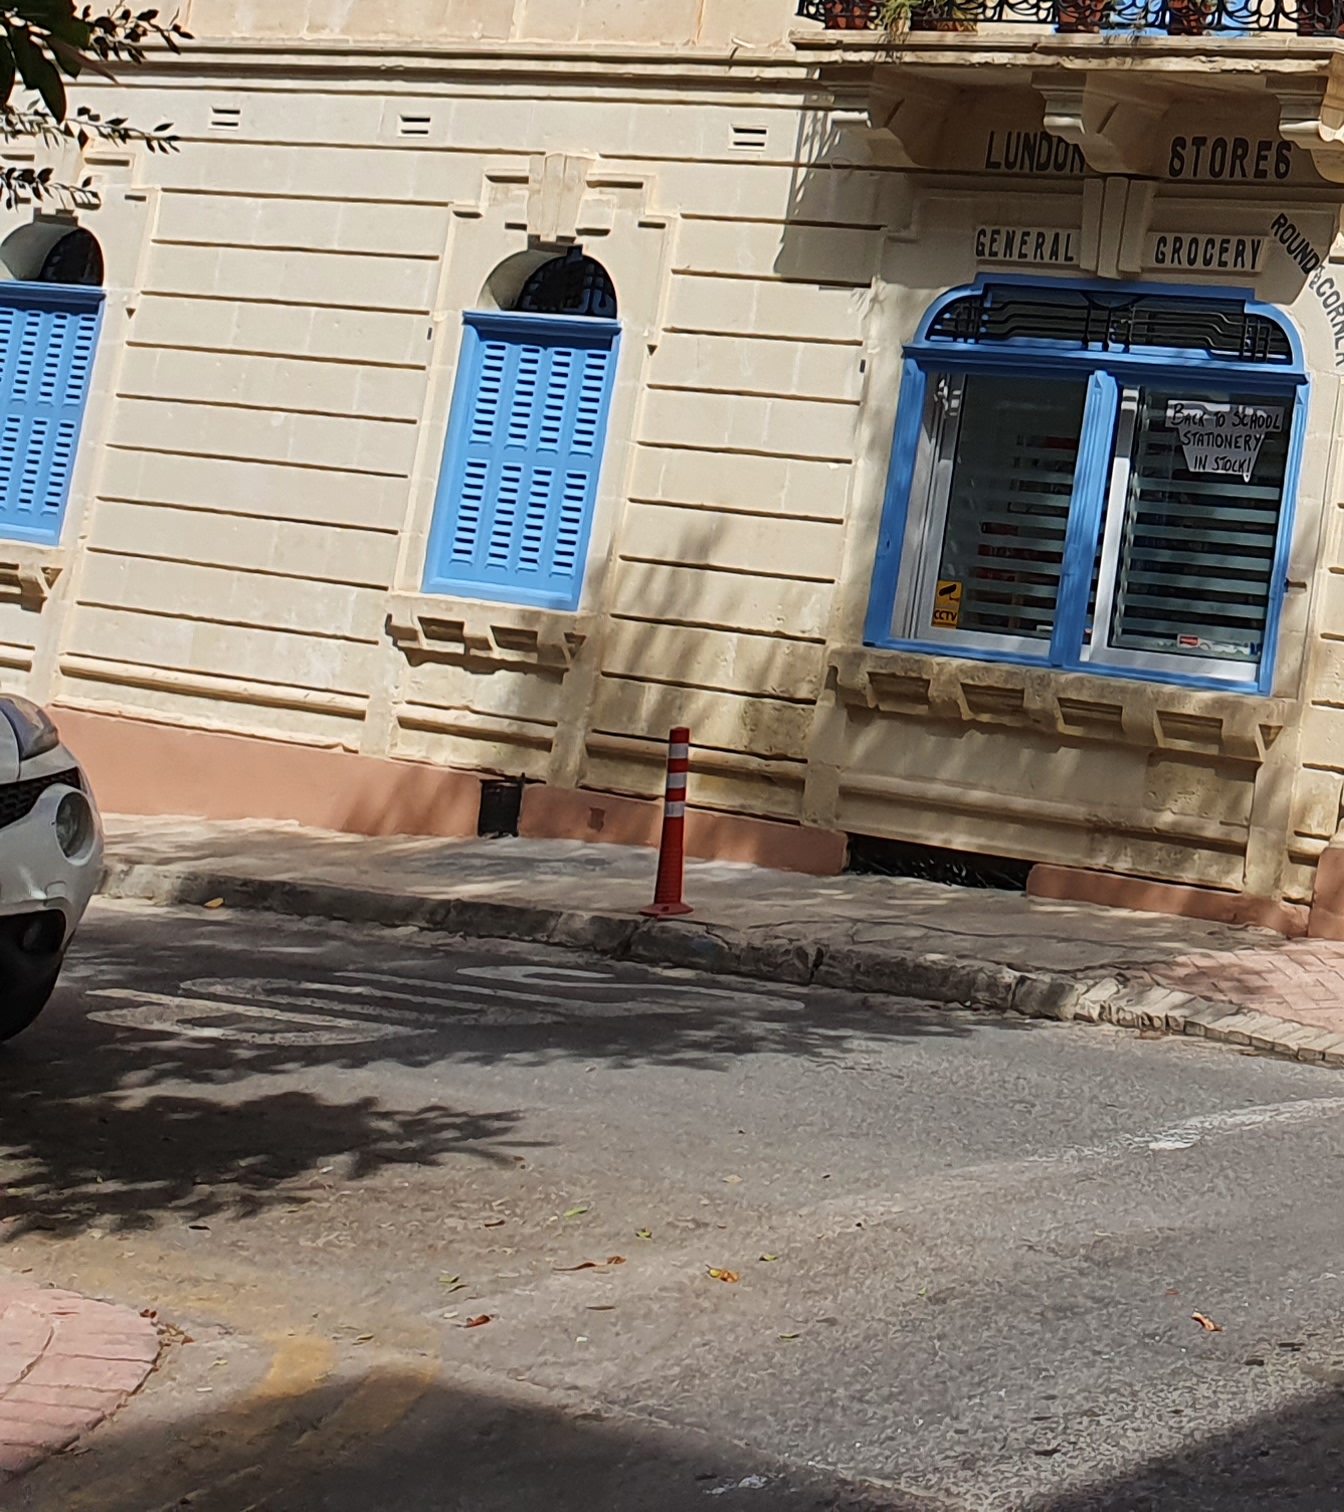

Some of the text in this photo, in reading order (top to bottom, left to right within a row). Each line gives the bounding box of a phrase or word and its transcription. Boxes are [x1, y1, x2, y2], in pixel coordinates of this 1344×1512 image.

[1168, 136, 1292, 179] STORES
[975, 228, 1261, 270] GENERAL GROCERY
[1270, 212, 1320, 275] ROUND
[1214, 410, 1226, 427] TO
[1231, 411, 1280, 430] SCHOOL
[1181, 430, 1262, 452] STATIONERY
[1194, 454, 1252, 476] IN STOCK!
[934, 610, 957, 621] CCTV
